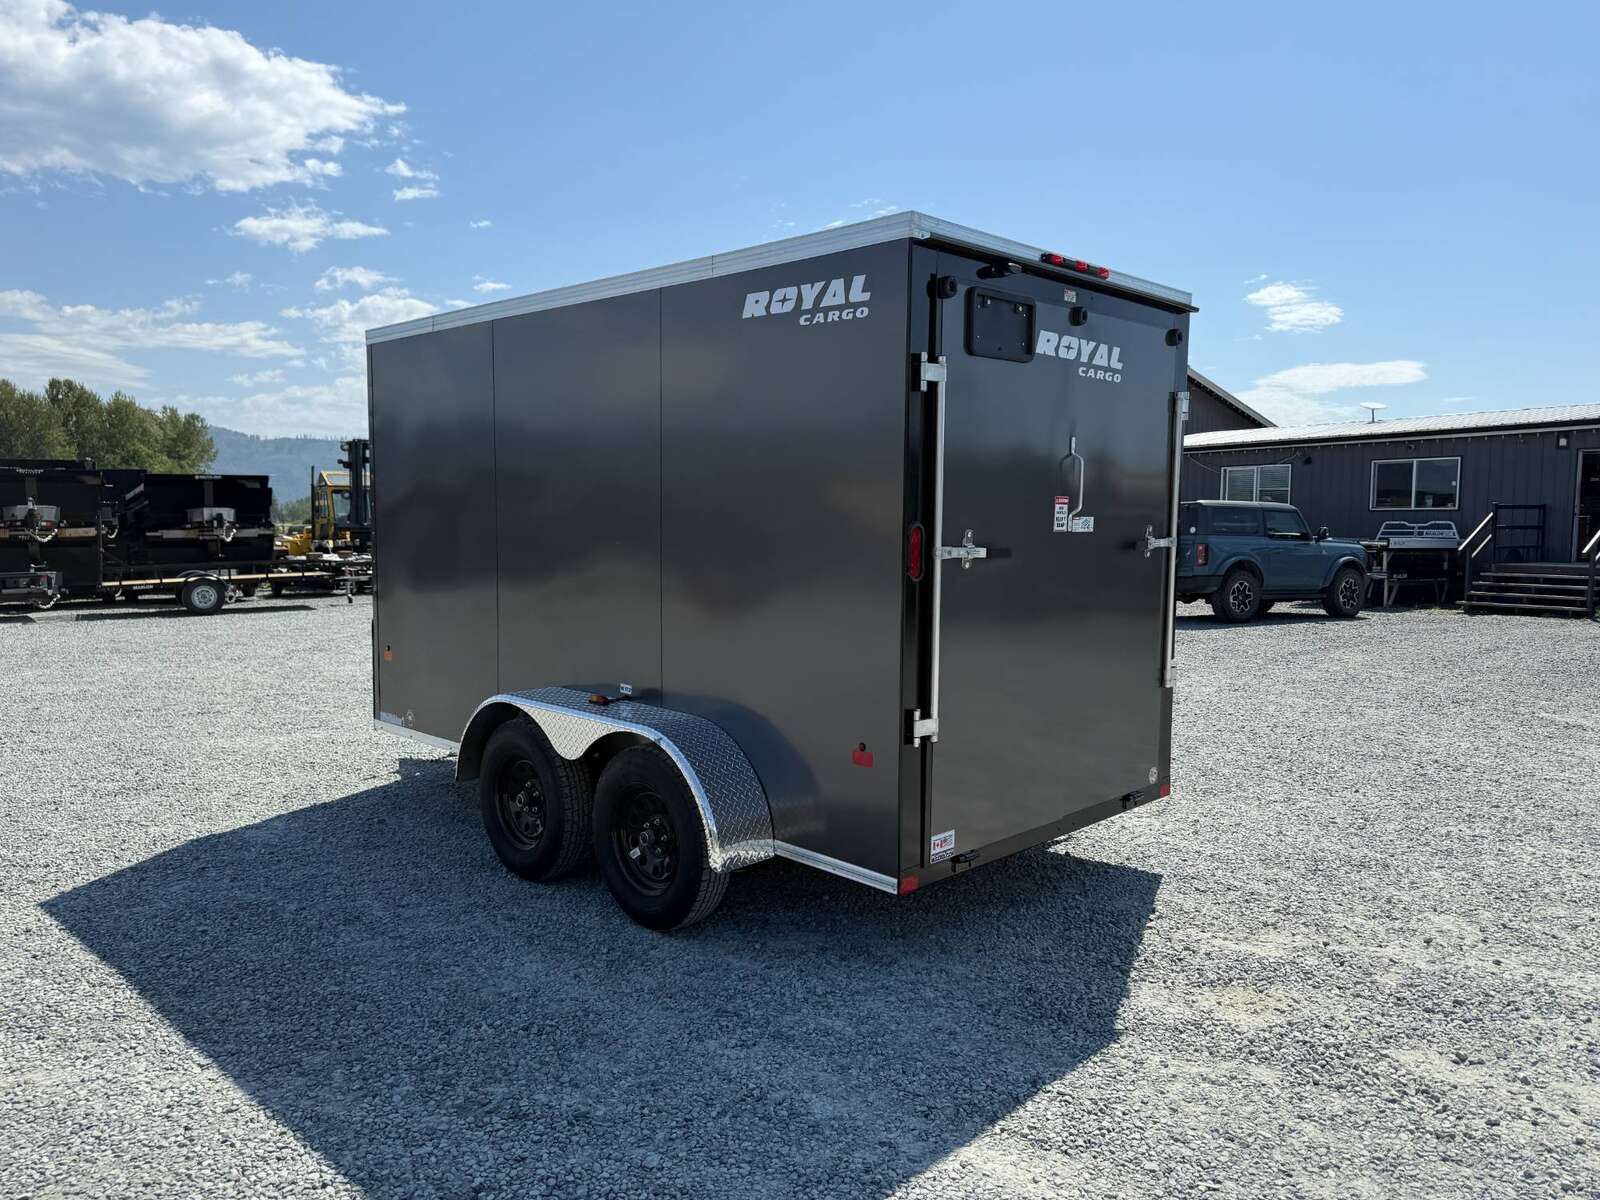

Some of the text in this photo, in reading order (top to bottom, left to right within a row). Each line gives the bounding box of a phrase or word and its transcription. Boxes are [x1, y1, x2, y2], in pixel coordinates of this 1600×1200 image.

[742, 274, 871, 319] ROYAL
[799, 306, 869, 326] CARGO
[1035, 329, 1124, 370] ROYAL
[1078, 366, 1122, 383] CARGO
